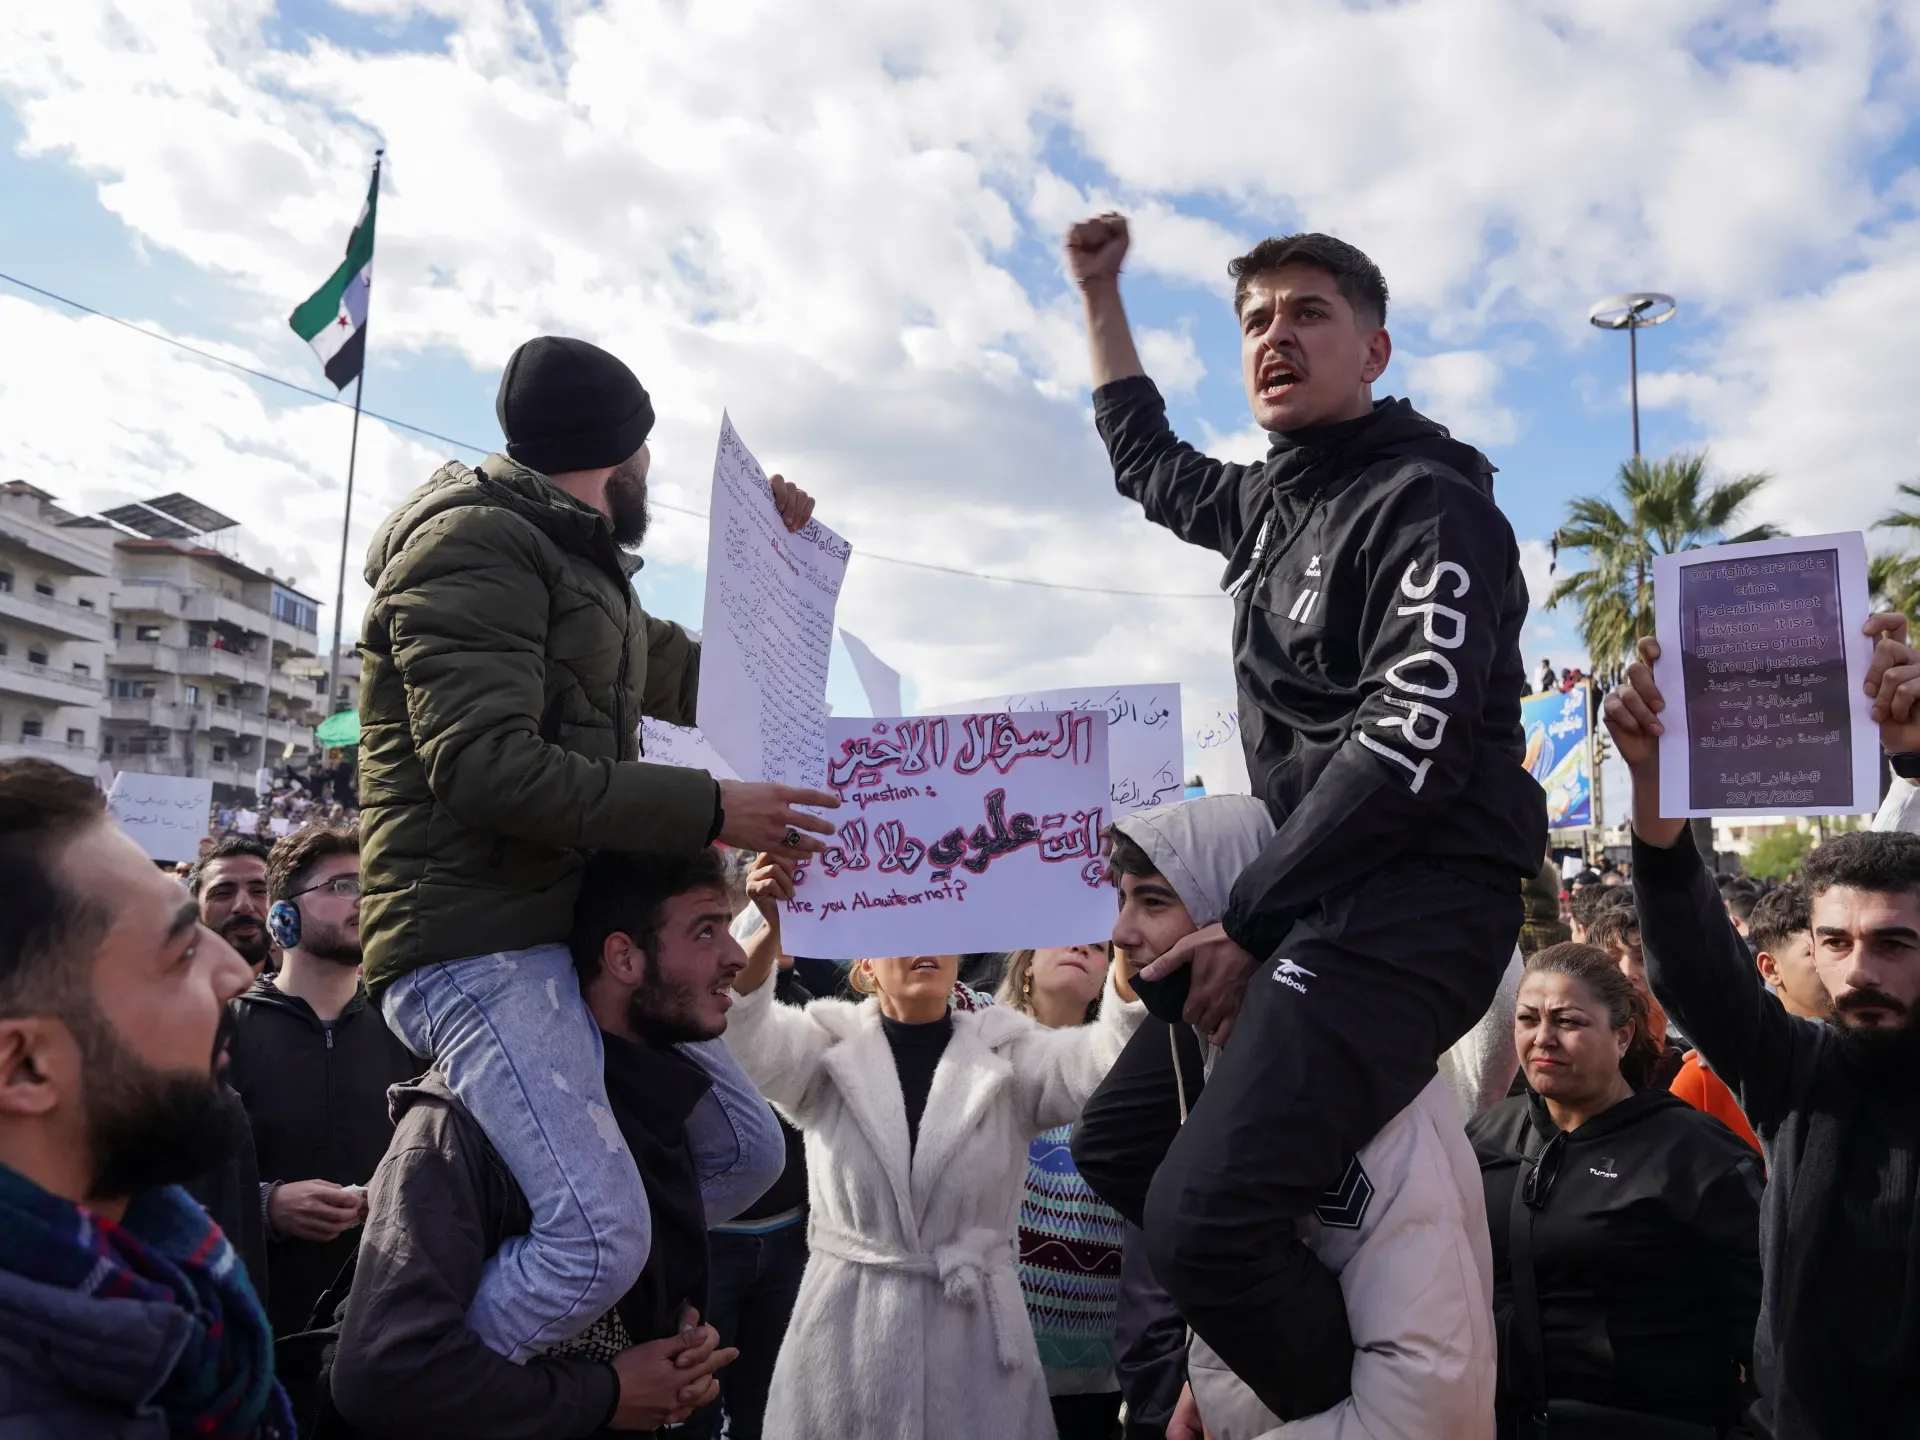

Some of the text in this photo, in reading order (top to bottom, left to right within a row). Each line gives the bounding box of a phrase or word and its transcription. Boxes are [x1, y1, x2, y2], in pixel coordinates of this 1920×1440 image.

[1689, 558, 1827, 582] Our rights are not a
[1734, 582, 1780, 596] crime.
[1698, 595, 1821, 619] Federalism is not
[1706, 617, 1814, 637] division... it is a
[1695, 634, 1828, 659] guarantee of unity
[1707, 655, 1820, 674] through justice.
[1359, 559, 1470, 794] SPORT
[1747, 675, 1781, 689] ليست
[1784, 674, 1827, 687] حقوقنا
[1719, 692, 1813, 710] الفيدرالية ليست
[852, 784, 919, 810] question
[1726, 789, 1814, 805] 28/12/2025
[786, 899, 814, 914] Are
[820, 901, 847, 920] you
[1272, 970, 1307, 994] Reebok
